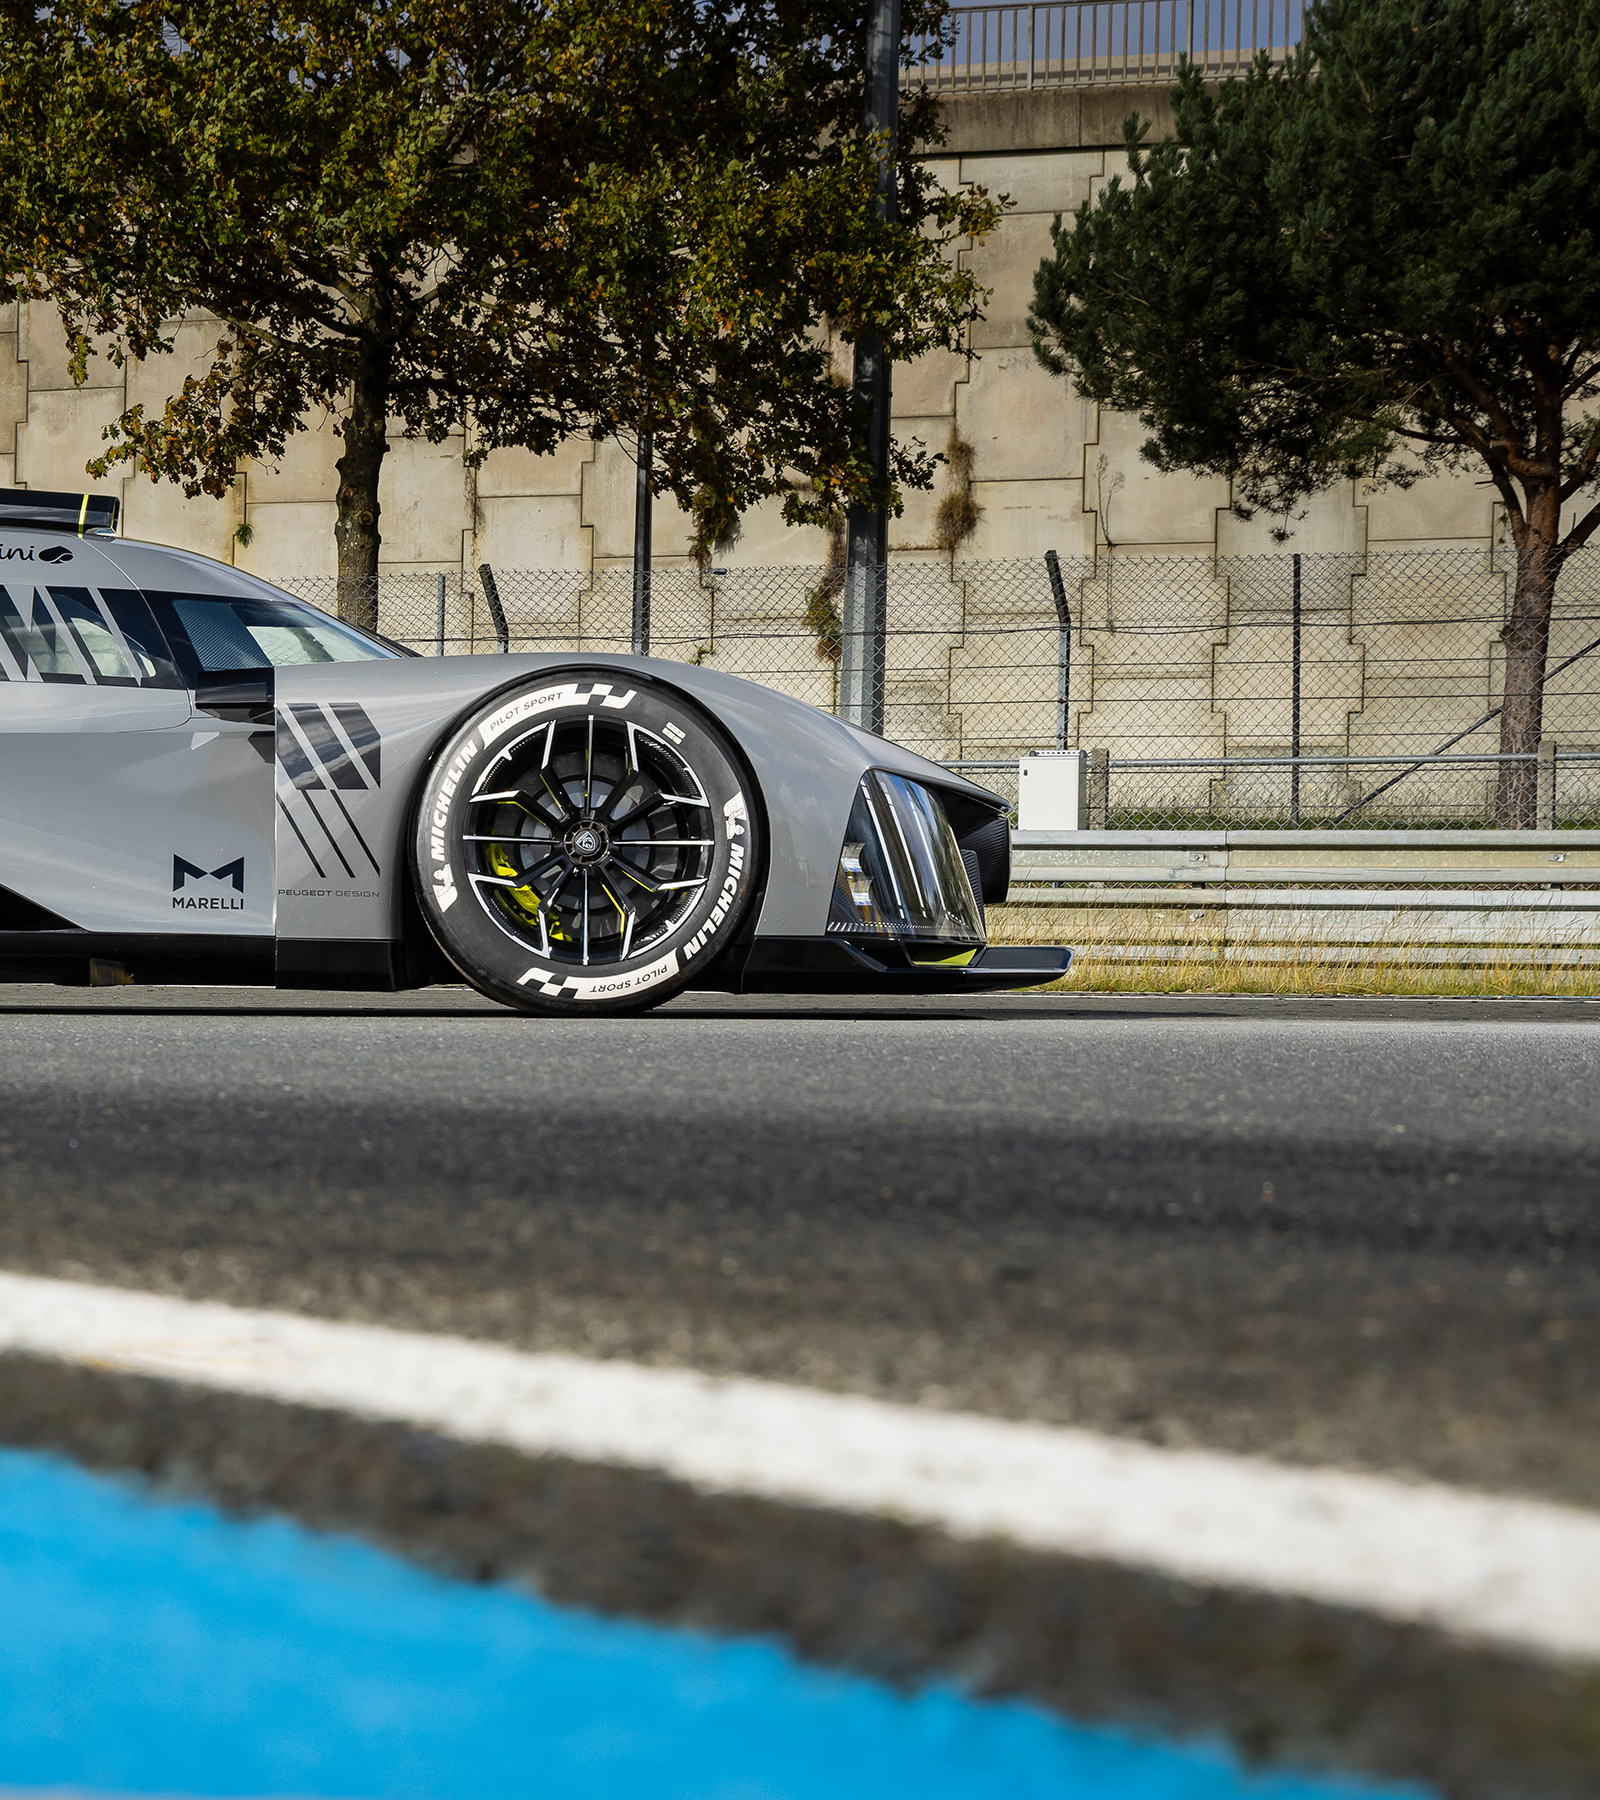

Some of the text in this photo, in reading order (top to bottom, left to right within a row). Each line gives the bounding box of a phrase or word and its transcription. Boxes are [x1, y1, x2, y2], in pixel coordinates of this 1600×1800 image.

[489, 692, 563, 732] PILOT SPORT
[430, 739, 479, 862] MICHELIN
[172, 897, 244, 910] MARELLI
[278, 889, 380, 898] PEUGEOT DESIGN
[682, 842, 745, 961] MICHELIN
[590, 964, 668, 993] PILOT SPORT
